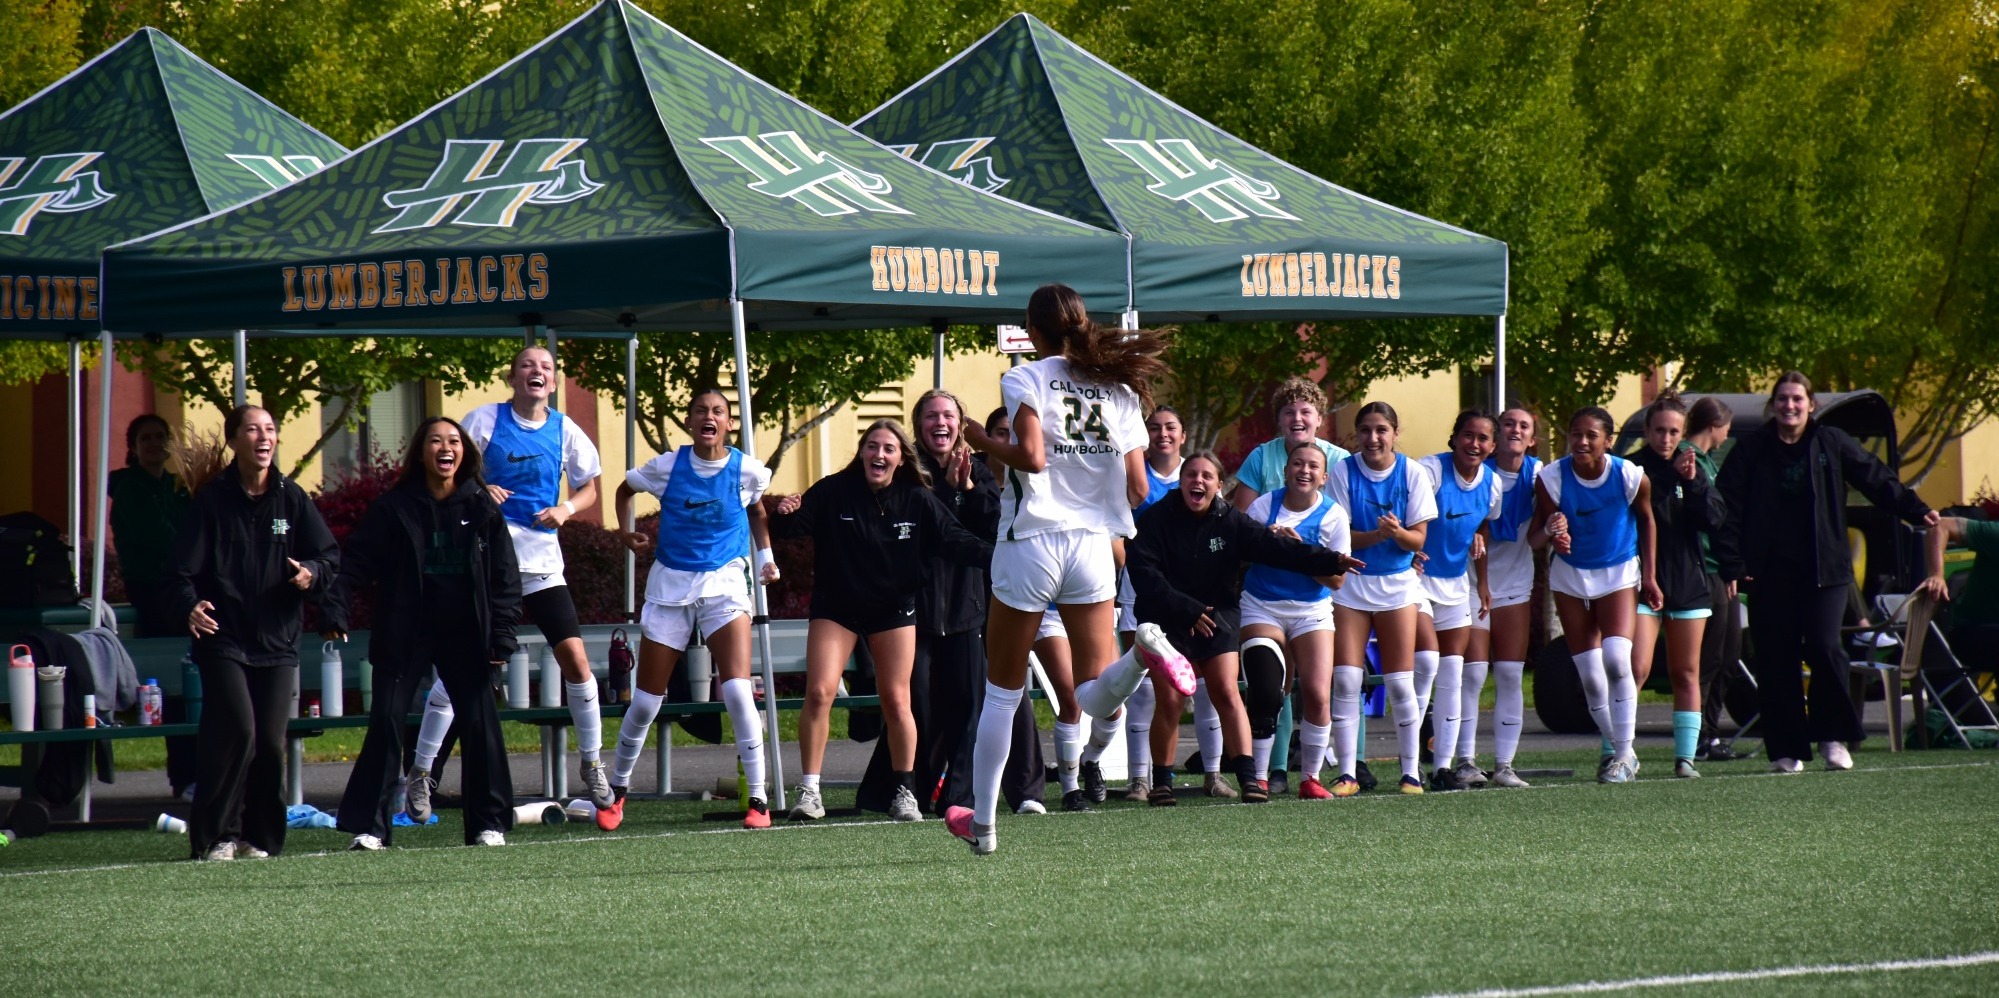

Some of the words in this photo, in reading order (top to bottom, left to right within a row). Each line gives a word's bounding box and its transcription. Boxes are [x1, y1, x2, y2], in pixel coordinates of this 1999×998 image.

[281, 252, 549, 312] LUMBERJACKS
[870, 245, 1000, 297] HUMBOLDT
[1240, 253, 1402, 300] LUMBERJACKS
[0, 275, 98, 320] ICINE
[1049, 379, 1076, 394] CAL
[1062, 396, 1110, 442] 24
